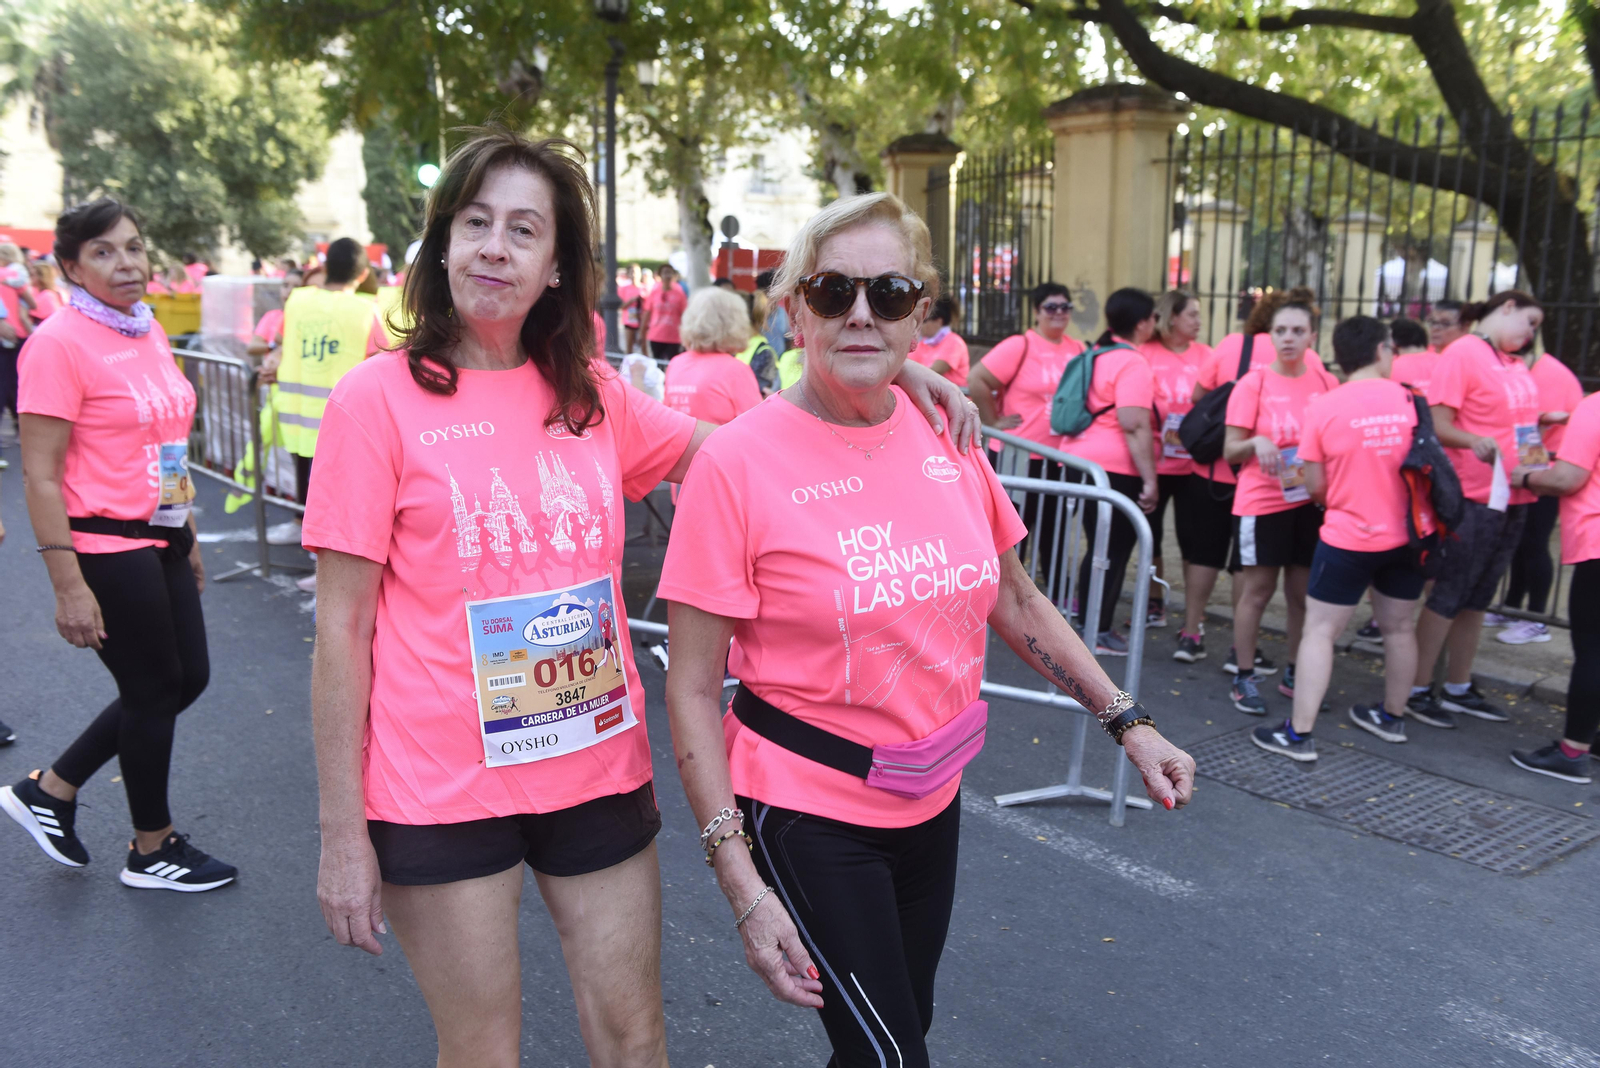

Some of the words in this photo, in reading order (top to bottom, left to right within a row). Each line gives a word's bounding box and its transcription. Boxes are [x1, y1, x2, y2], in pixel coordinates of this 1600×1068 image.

[102, 347, 140, 366] OYSHO
[302, 334, 340, 362] Life
[1350, 414, 1408, 429] CARRERA
[1363, 426, 1380, 438] DE
[1383, 425, 1399, 436] LA
[419, 421, 495, 446] OYSHO
[1362, 435, 1402, 448] MUJER
[791, 476, 864, 504] OYSHO
[837, 521, 893, 556] HOY
[846, 539, 948, 582] GANAN
[853, 578, 905, 615] LAS
[911, 557, 1000, 602] CHICAS
[483, 624, 514, 636] SUMA
[490, 616, 513, 625] DORSAL
[529, 617, 592, 641] ASTURIANA
[541, 616, 568, 626] CENTRAL
[533, 648, 596, 688] 016
[555, 686, 587, 706] 3847
[521, 710, 565, 727] CARRERA
[566, 707, 577, 717] DE
[578, 703, 589, 714] LA
[589, 694, 610, 710] MUJER
[602, 712, 621, 725] Santander
[501, 733, 559, 755] OYSHO
